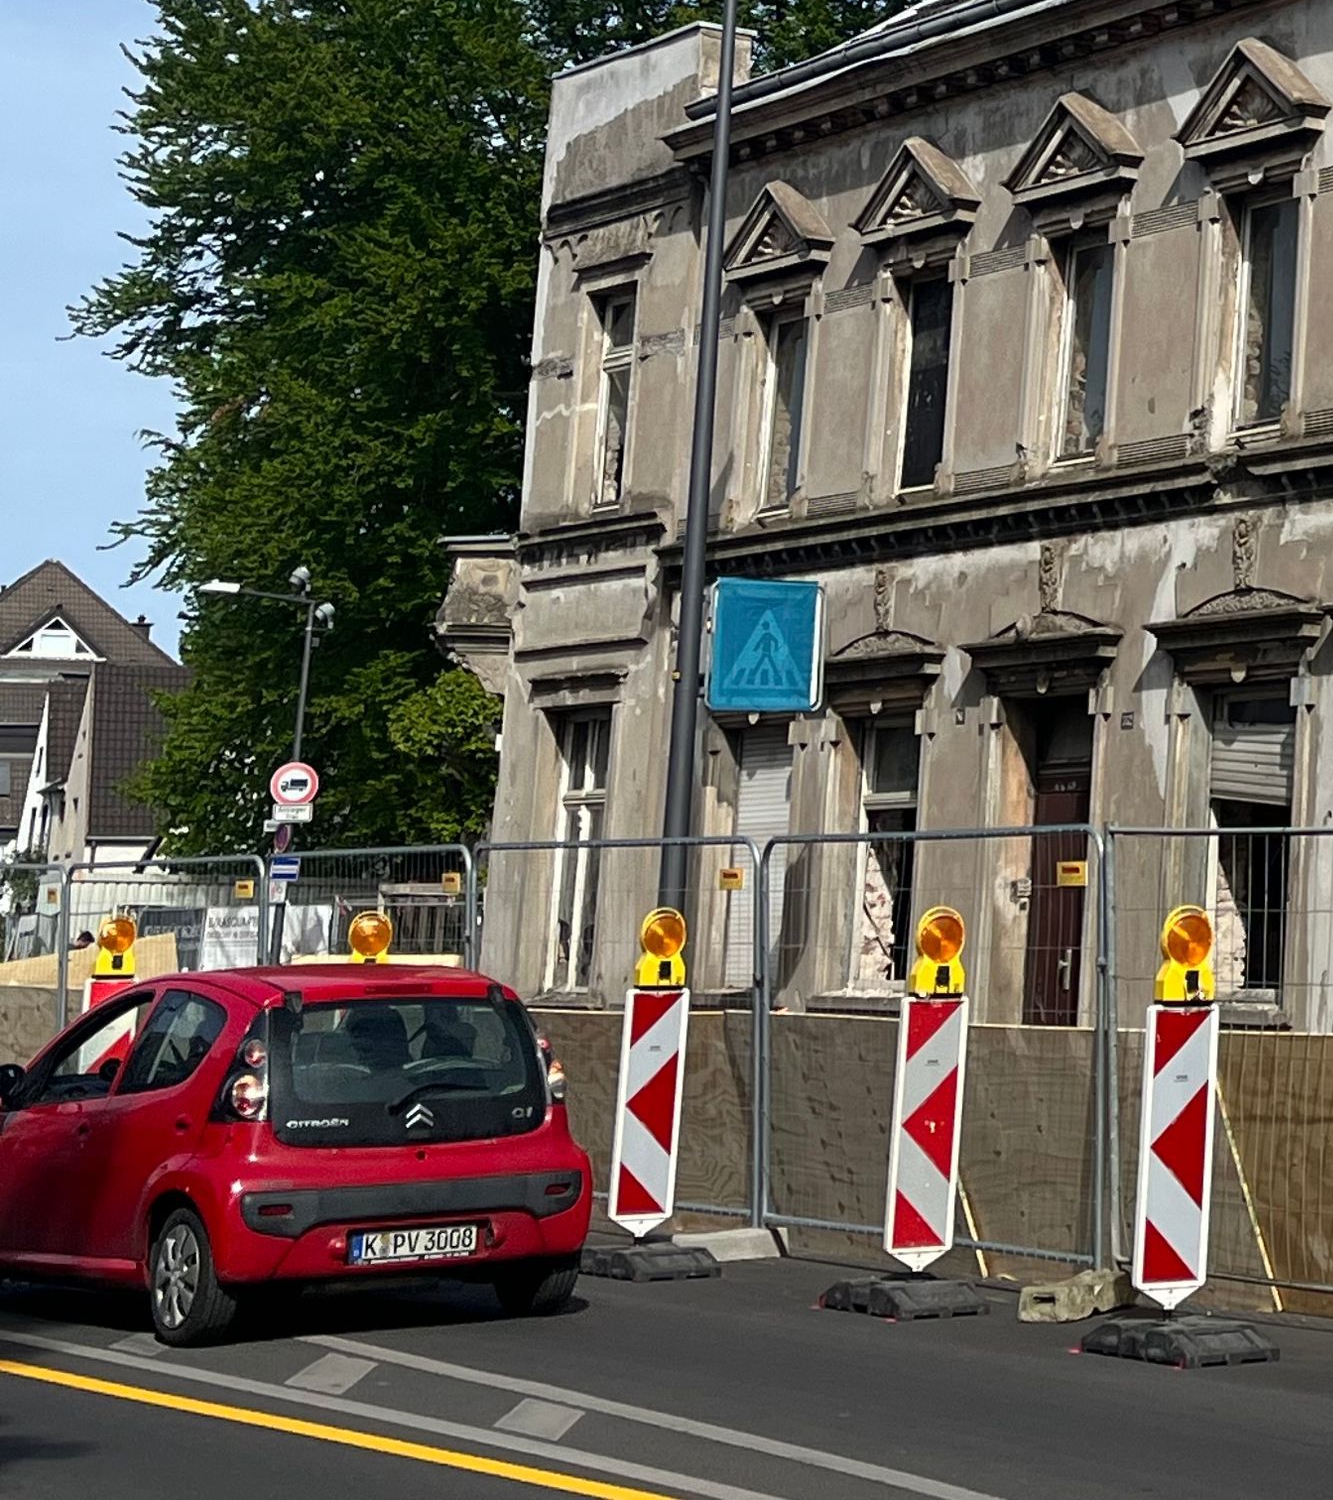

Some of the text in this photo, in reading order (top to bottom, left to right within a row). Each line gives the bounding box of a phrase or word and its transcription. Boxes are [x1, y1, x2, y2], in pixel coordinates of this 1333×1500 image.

[364, 1227, 474, 1257] K PV 3008
